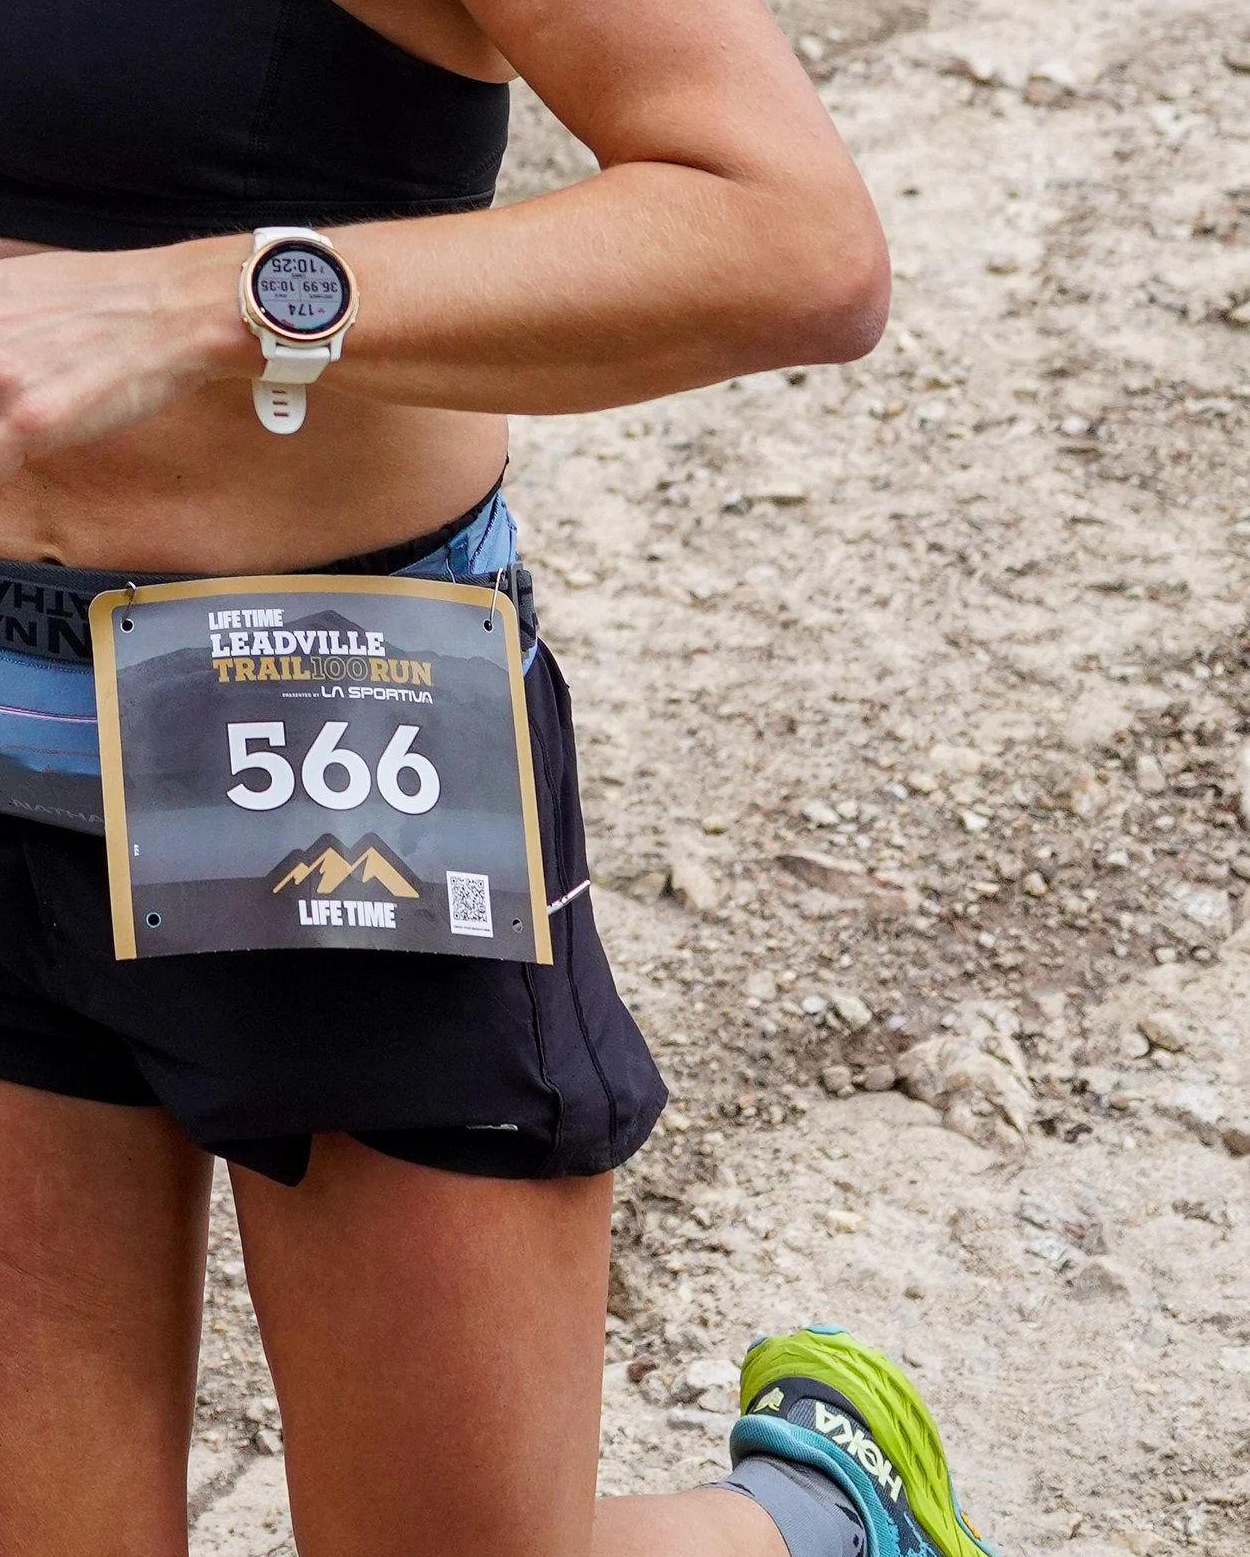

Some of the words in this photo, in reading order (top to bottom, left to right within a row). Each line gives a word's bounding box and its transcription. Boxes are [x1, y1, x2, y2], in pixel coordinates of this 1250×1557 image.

[271, 258, 317, 273] 10:25
[210, 630, 386, 658] LEADVILLE
[212, 655, 311, 683] TRAIL
[368, 660, 434, 686] RUN
[321, 685, 345, 699] LA
[348, 686, 434, 705] SPORTIVA
[225, 720, 441, 815] 566
[10, 797, 105, 823] NATHA
[815, 1401, 903, 1503] HOKA
